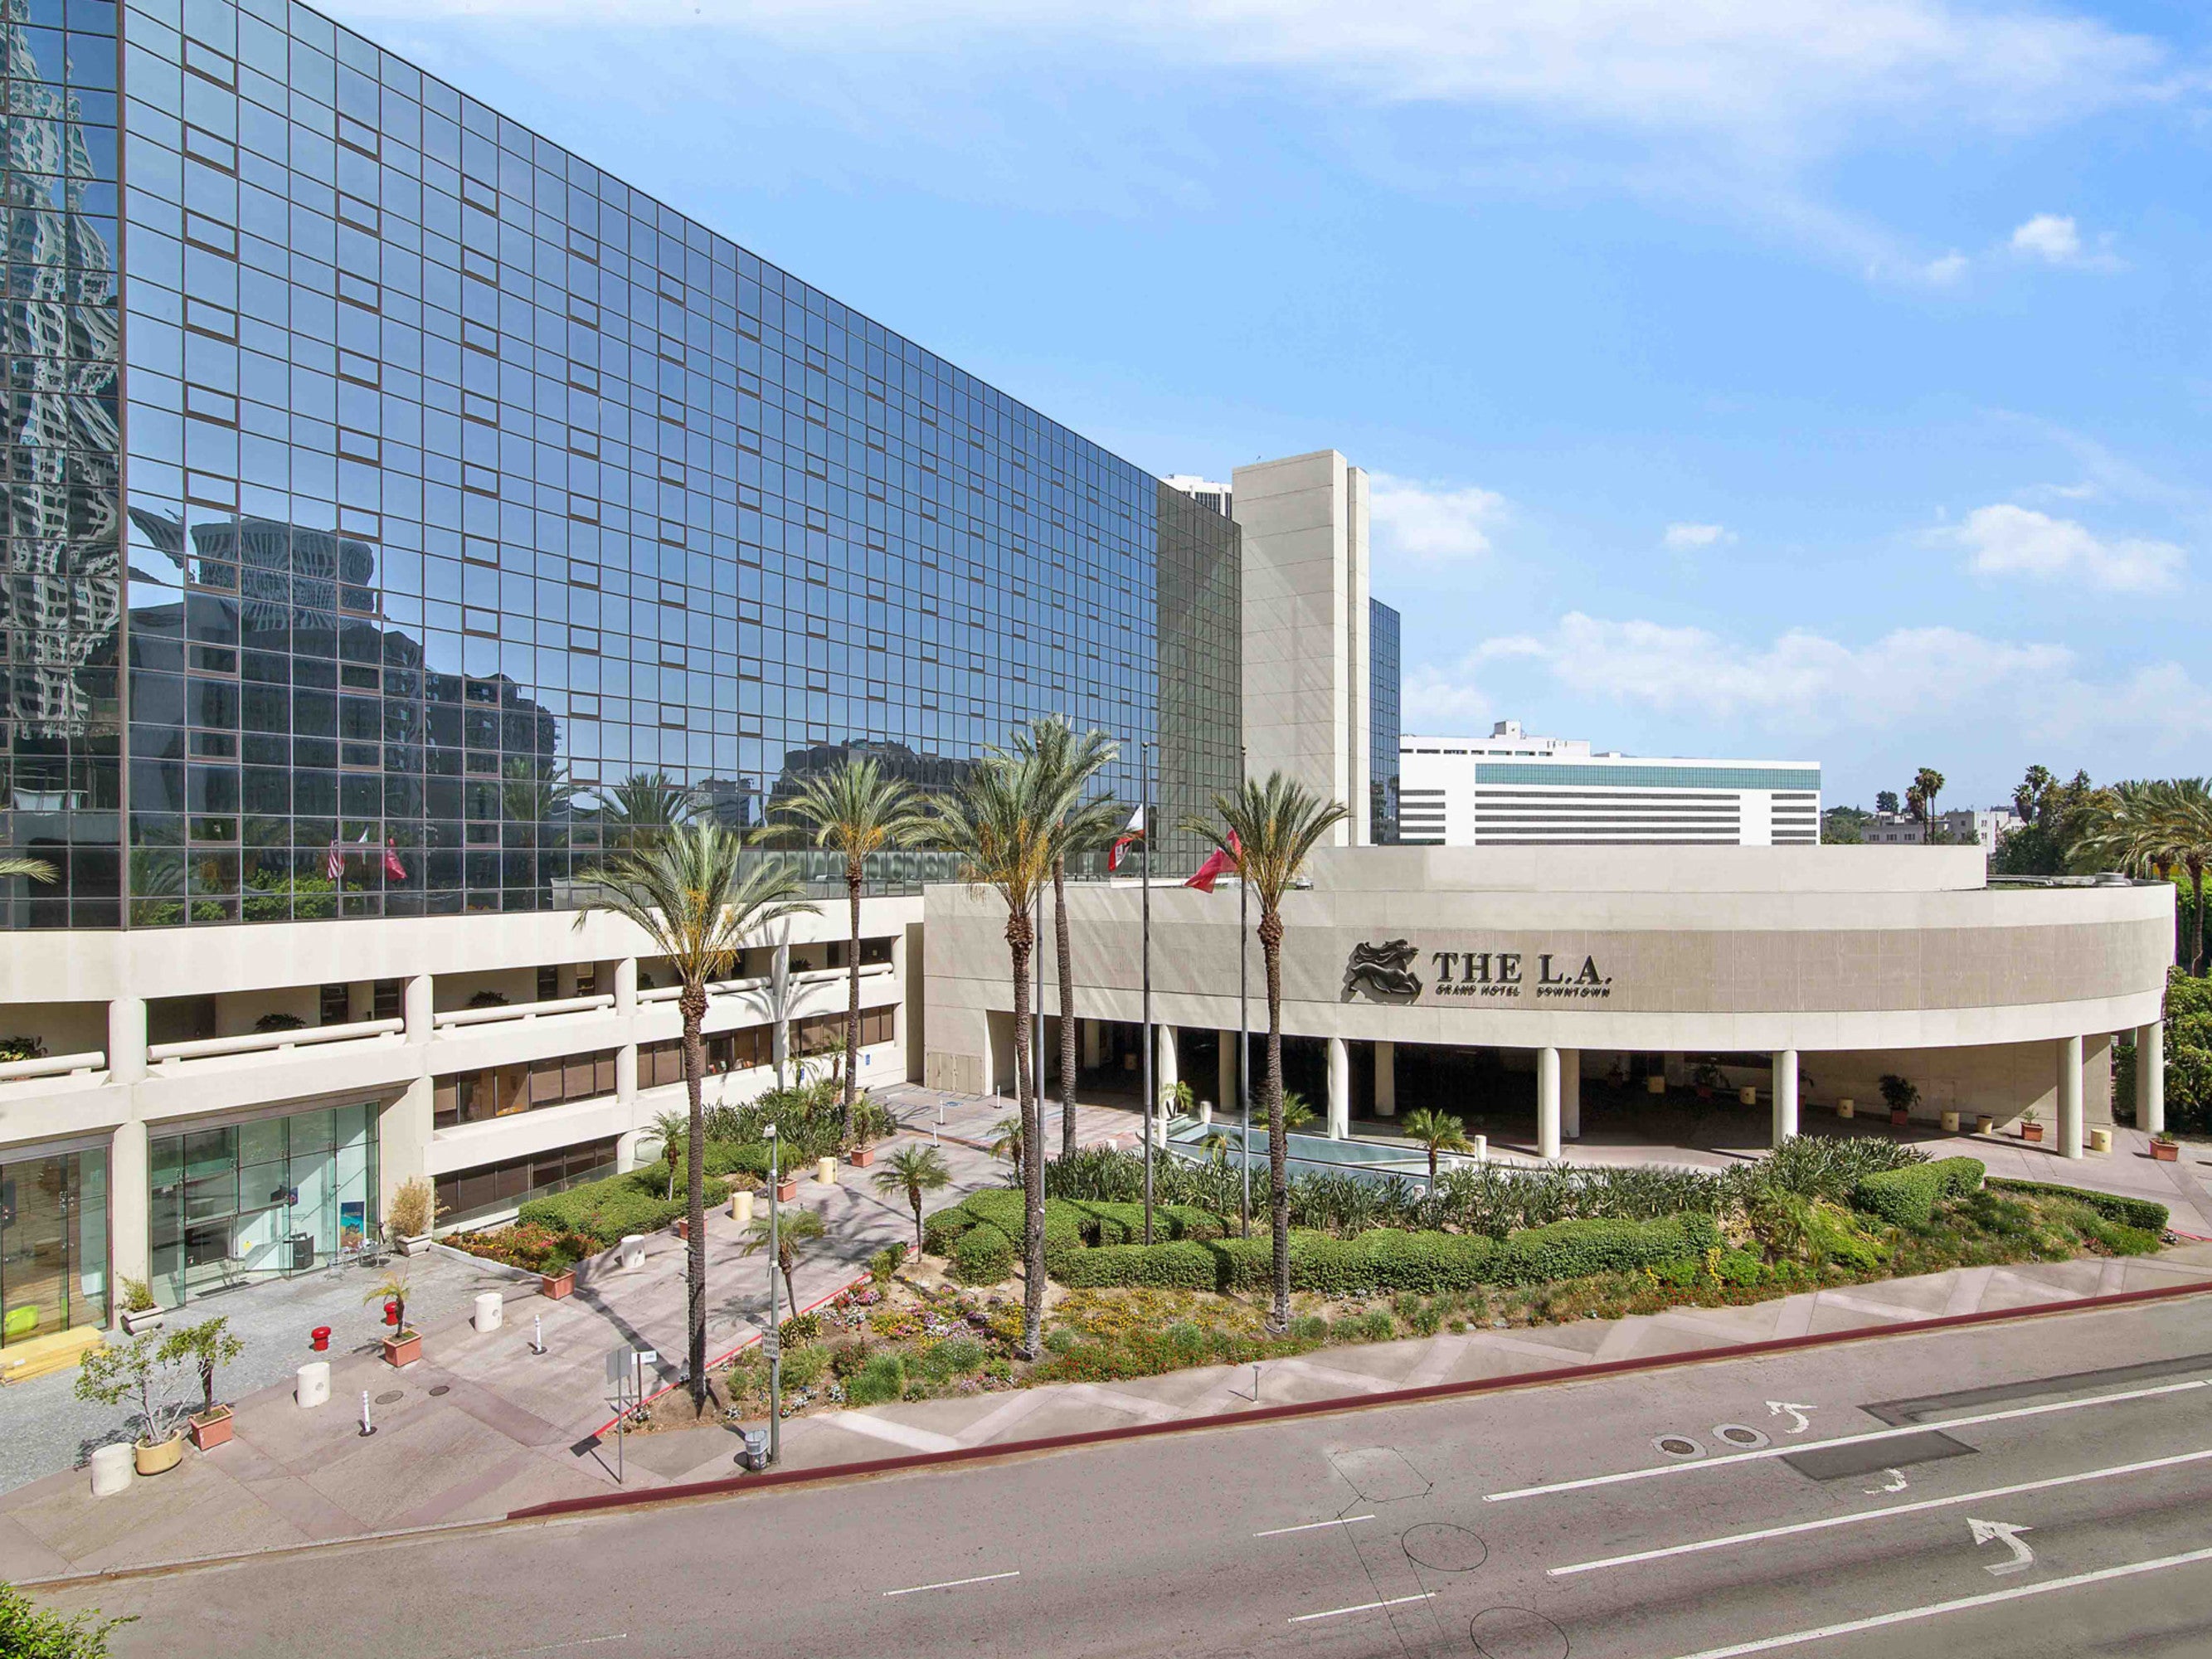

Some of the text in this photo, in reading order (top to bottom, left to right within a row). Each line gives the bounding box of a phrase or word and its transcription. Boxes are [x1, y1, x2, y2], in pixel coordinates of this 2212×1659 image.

[1432, 952, 1612, 985] THE L.A.
[1435, 984, 1611, 998] GRAND HOTEL DOWNTOWN
